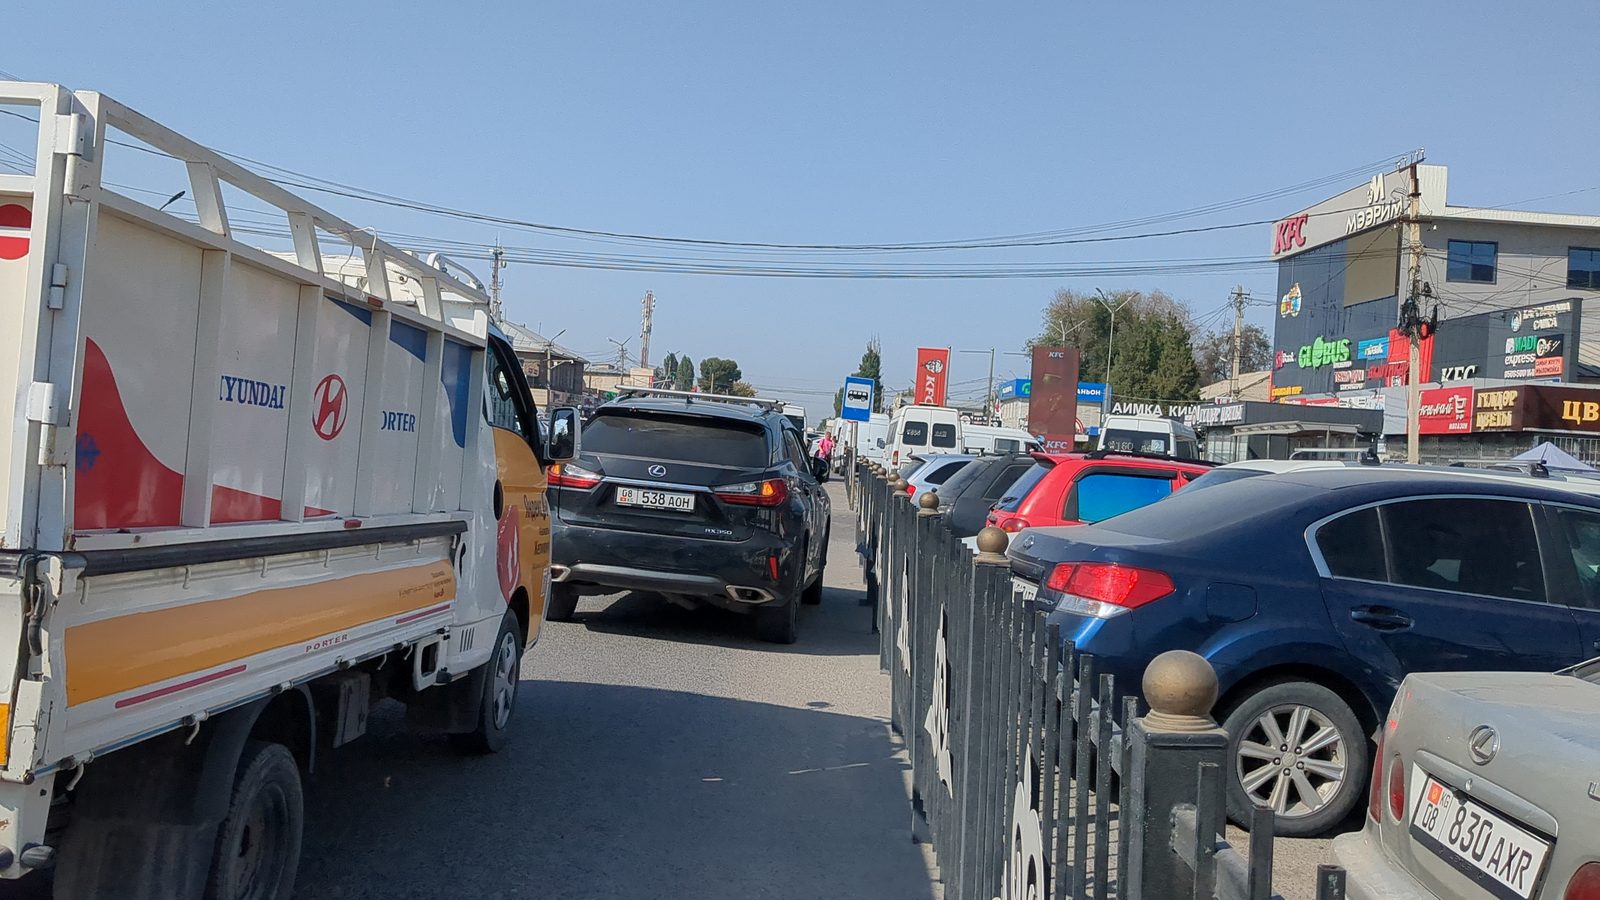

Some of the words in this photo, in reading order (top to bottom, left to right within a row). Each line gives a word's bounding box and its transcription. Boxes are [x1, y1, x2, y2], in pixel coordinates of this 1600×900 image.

[1273, 213, 1309, 255] KFC
[1049, 351, 1064, 359] KFC
[1298, 336, 1352, 369] GLOBUS
[1504, 353, 1537, 367] express
[1441, 365, 1476, 383] KFC
[220, 375, 286, 409] YUNDAI
[925, 374, 936, 405] KFC
[1046, 441, 1068, 450] KFC
[641, 491, 666, 506] 538
[668, 496, 690, 508] AOH
[305, 634, 348, 653] PORTER
[1440, 792, 1451, 808] KG
[1448, 806, 1493, 863] 830
[1486, 837, 1533, 890] AXR
